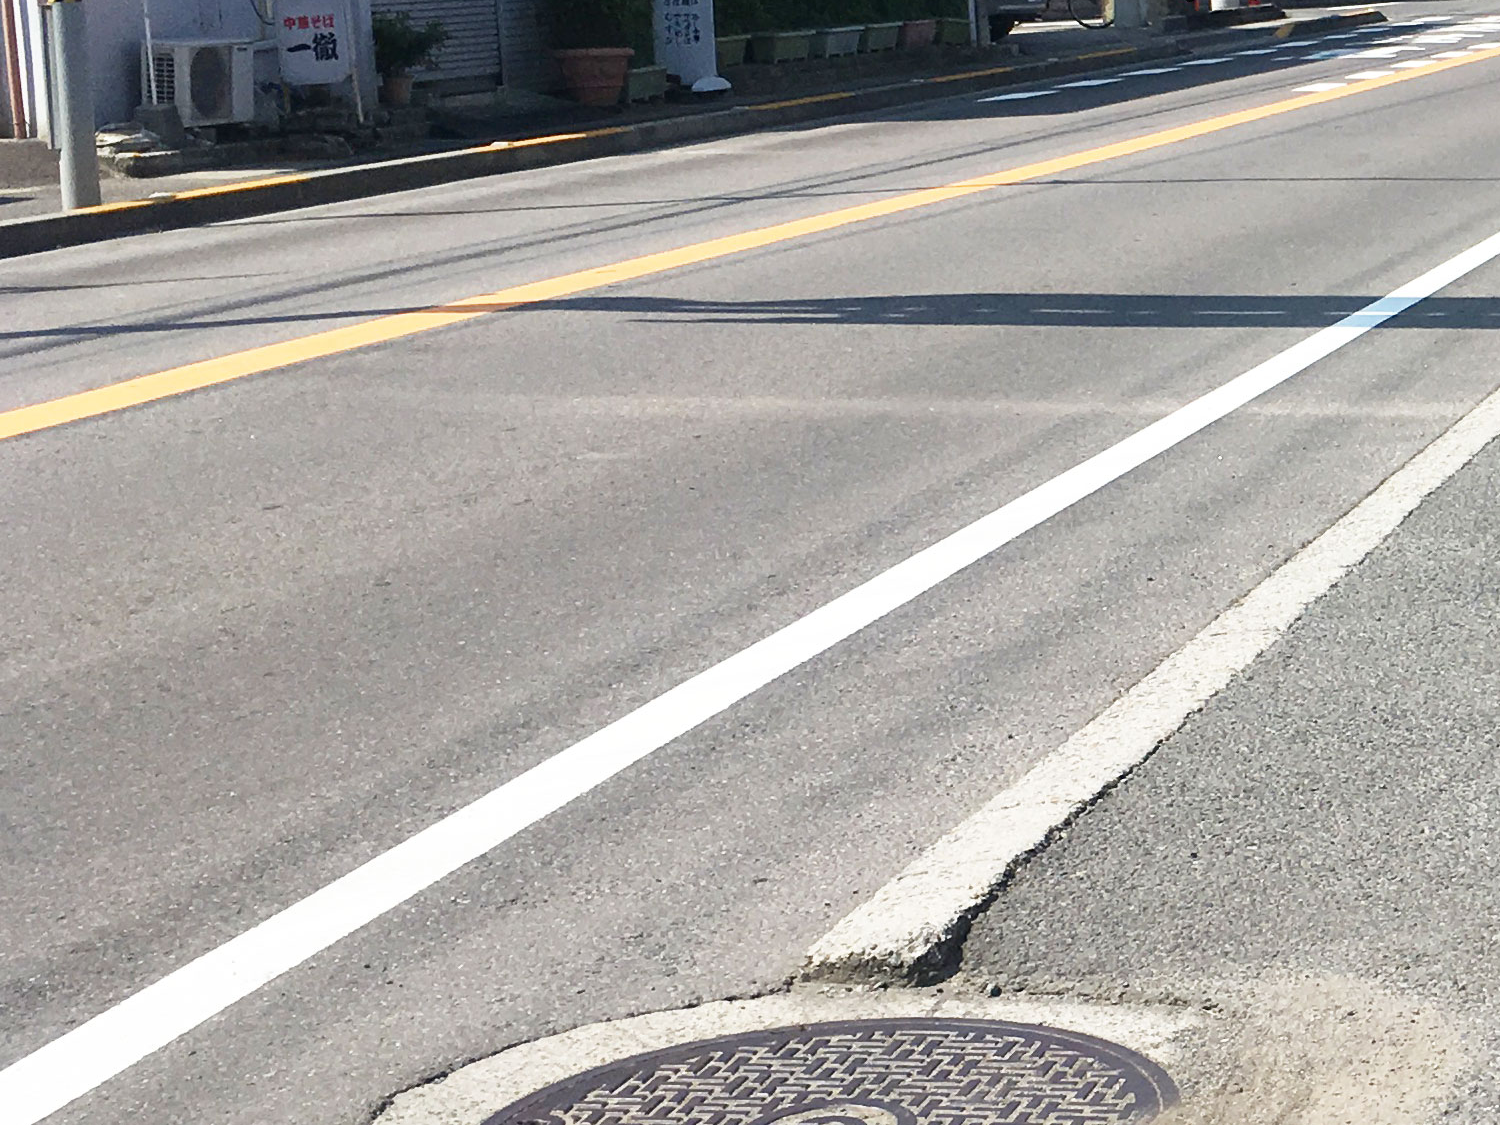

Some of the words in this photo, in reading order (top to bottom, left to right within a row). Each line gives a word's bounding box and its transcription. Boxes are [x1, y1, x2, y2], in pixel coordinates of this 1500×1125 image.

[283, 13, 335, 31] 中華そば
[286, 31, 339, 62] 一徹
